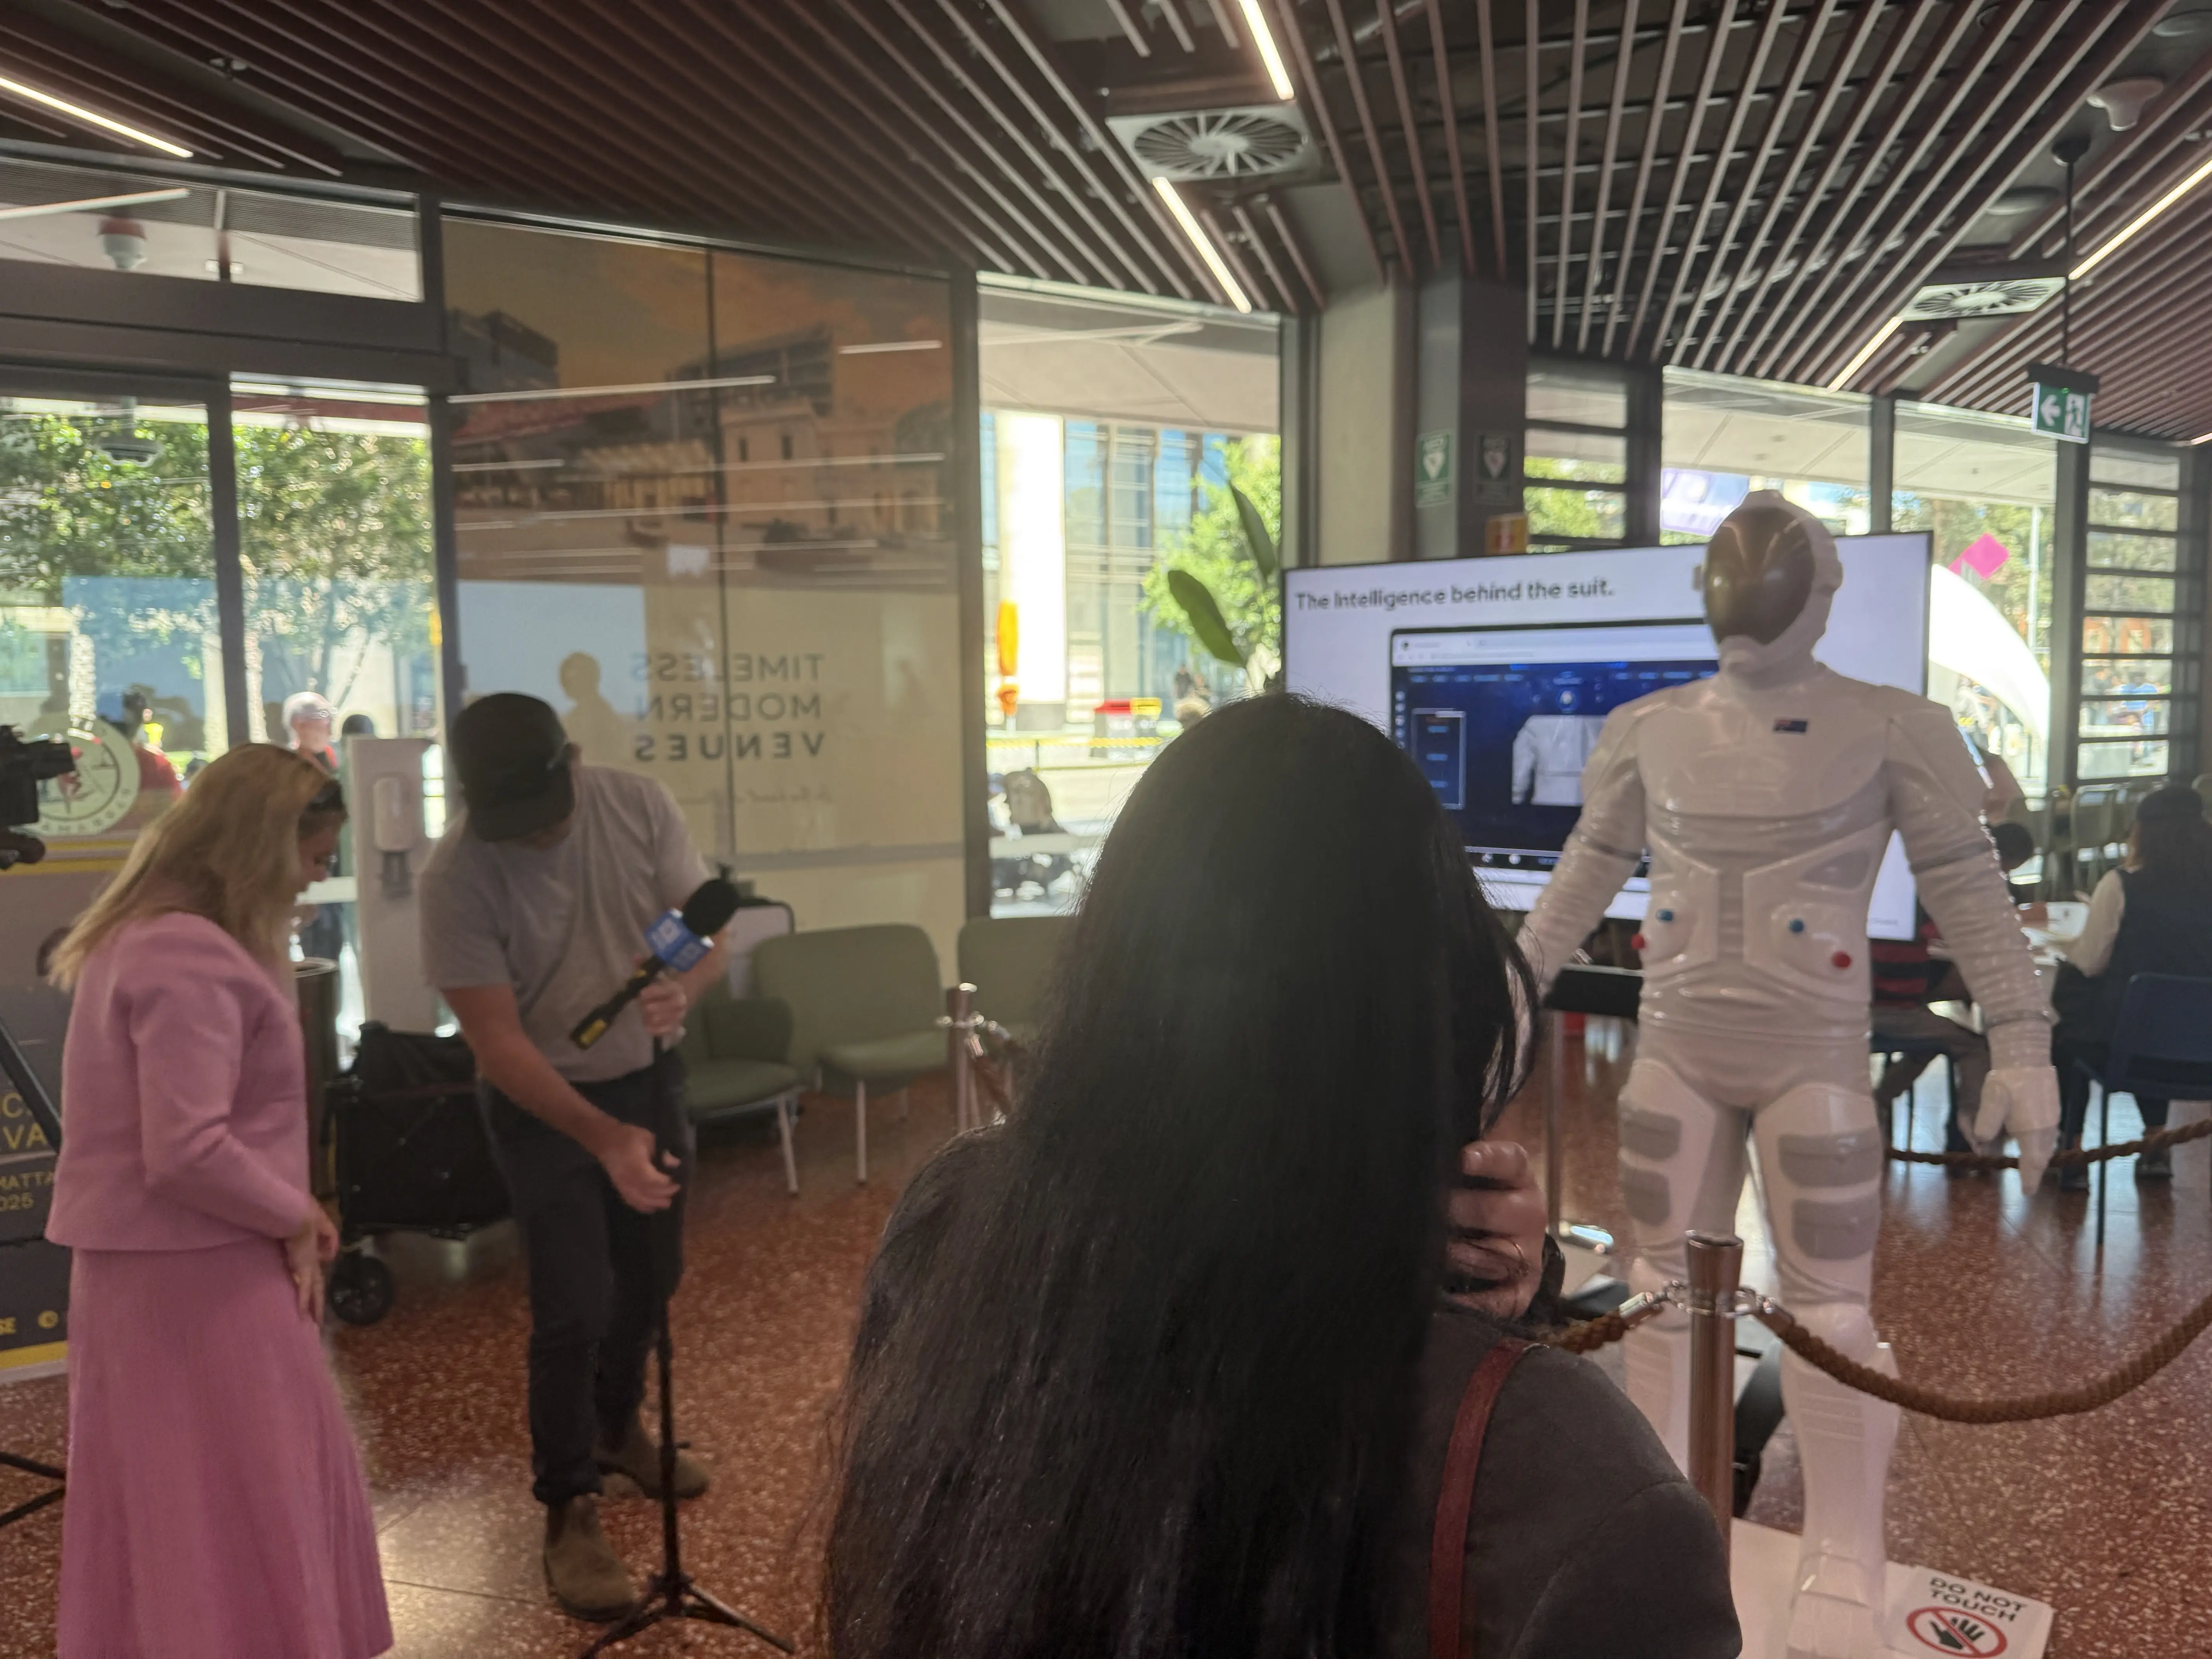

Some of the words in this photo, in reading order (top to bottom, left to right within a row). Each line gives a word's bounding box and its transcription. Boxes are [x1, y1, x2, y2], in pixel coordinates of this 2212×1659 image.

[1295, 590, 1330, 610] The
[1450, 582, 1522, 603] behind
[1527, 579, 1561, 599] the
[1568, 576, 1615, 598] suit.
[1930, 1577, 1966, 1594] DO
[1973, 1590, 2028, 1611] NOT
[1931, 1588, 2016, 1622] TOUCH
